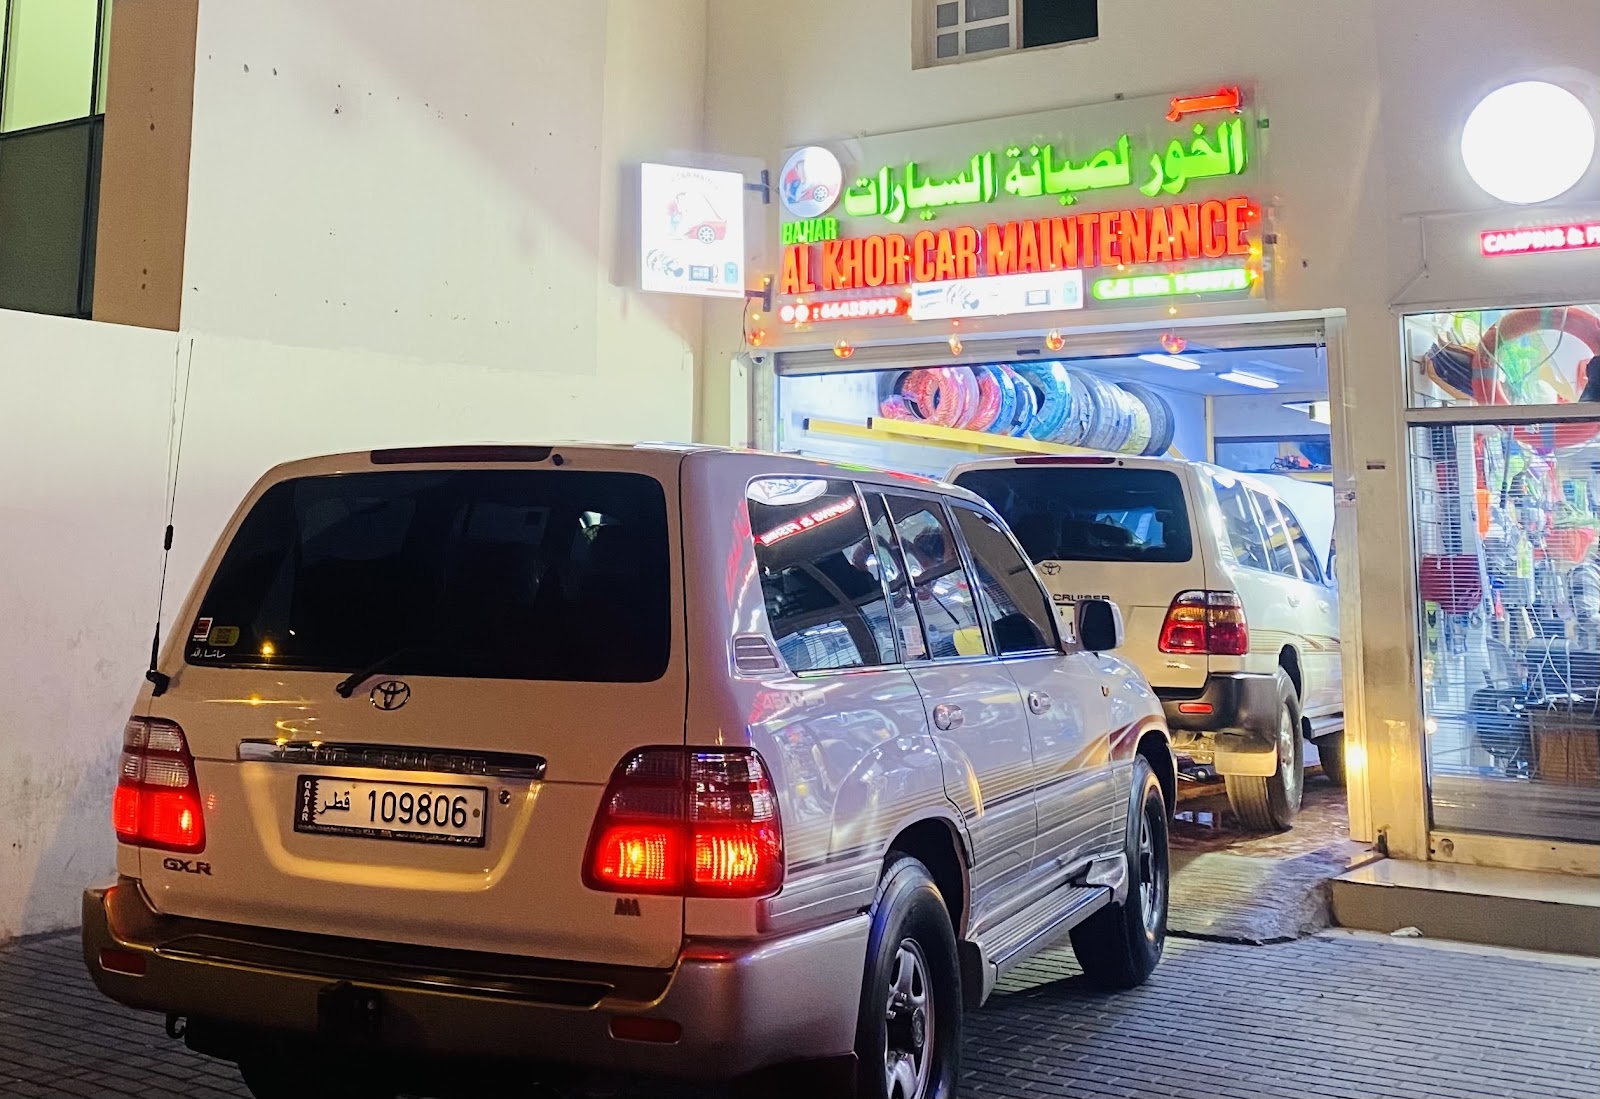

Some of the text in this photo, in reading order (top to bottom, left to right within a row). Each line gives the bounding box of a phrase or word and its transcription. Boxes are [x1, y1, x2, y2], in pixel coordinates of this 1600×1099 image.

[844, 118, 1247, 224] الخور لصيانة السيارات
[780, 197, 1251, 295] AL KHOR CAR MAINTENANCE
[781, 217, 839, 245] BAHAR
[302, 780, 312, 821] QATAR
[316, 790, 351, 815] قطر
[368, 790, 467, 828] 109806
[163, 857, 213, 876] GXR
